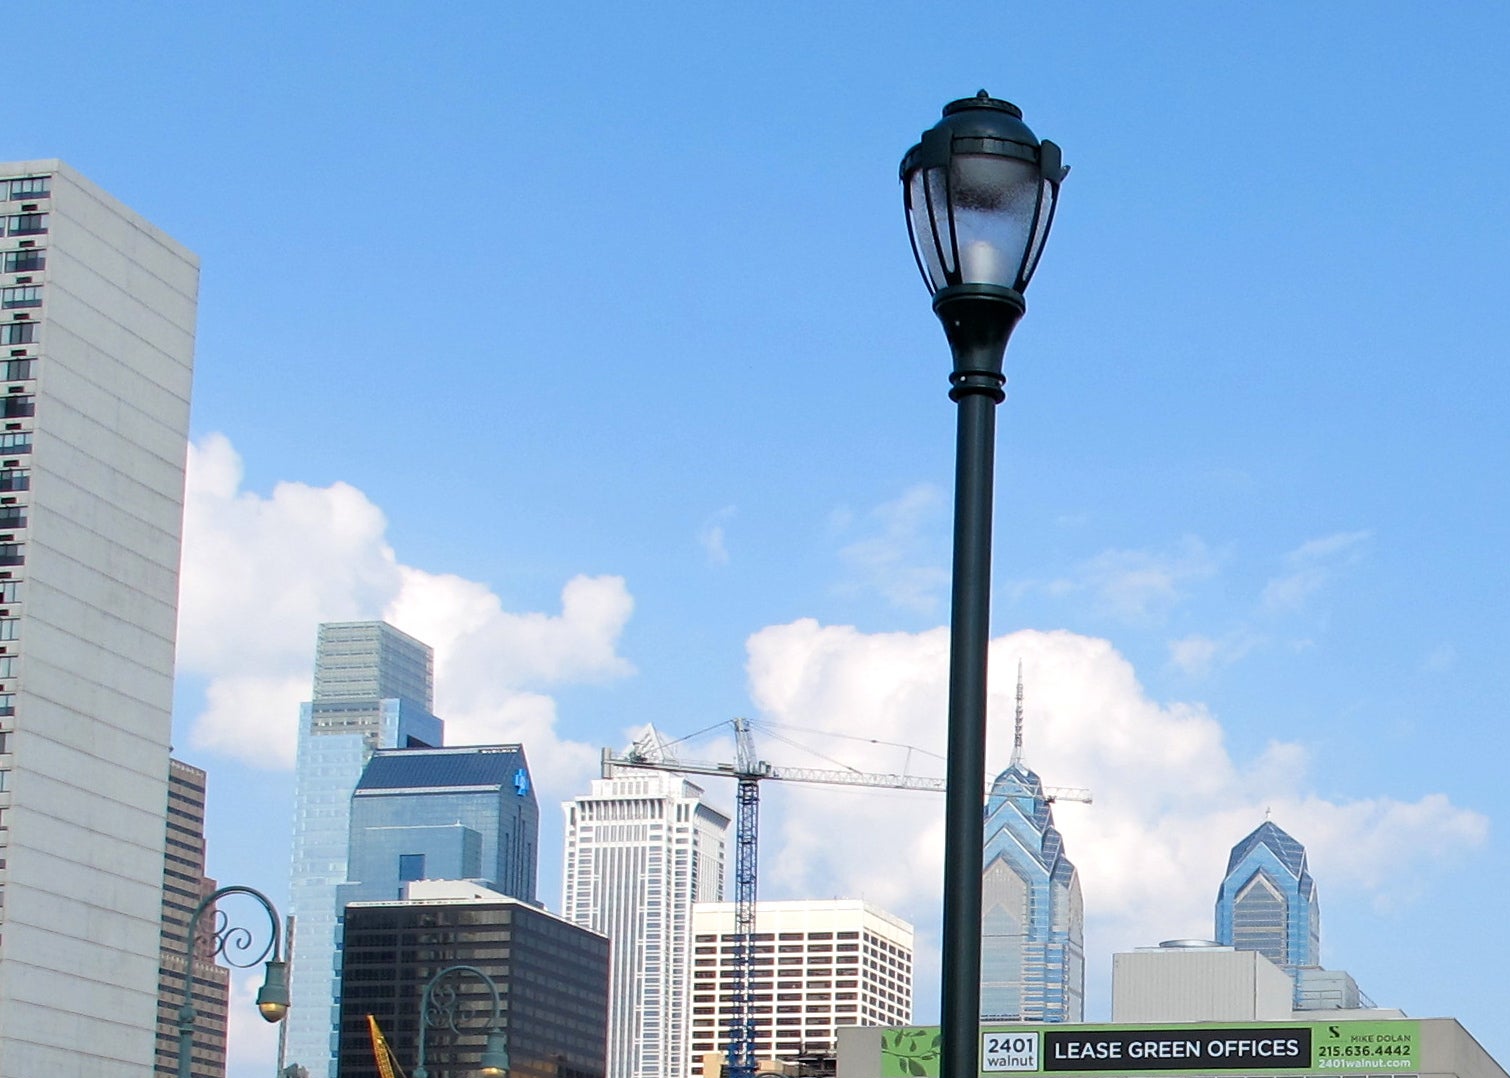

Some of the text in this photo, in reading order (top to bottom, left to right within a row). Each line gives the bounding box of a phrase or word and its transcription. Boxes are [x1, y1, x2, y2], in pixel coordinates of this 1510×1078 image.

[1350, 1034, 1411, 1043] MIKE DOLAN
[988, 1037, 1033, 1054] 2401
[1054, 1039, 1300, 1059] LEASE GREEN OFFICES
[1318, 1045, 1411, 1057] 215.636.4442
[988, 1055, 1034, 1067] walnut
[1318, 1059, 1411, 1069] 2401walnut.com
